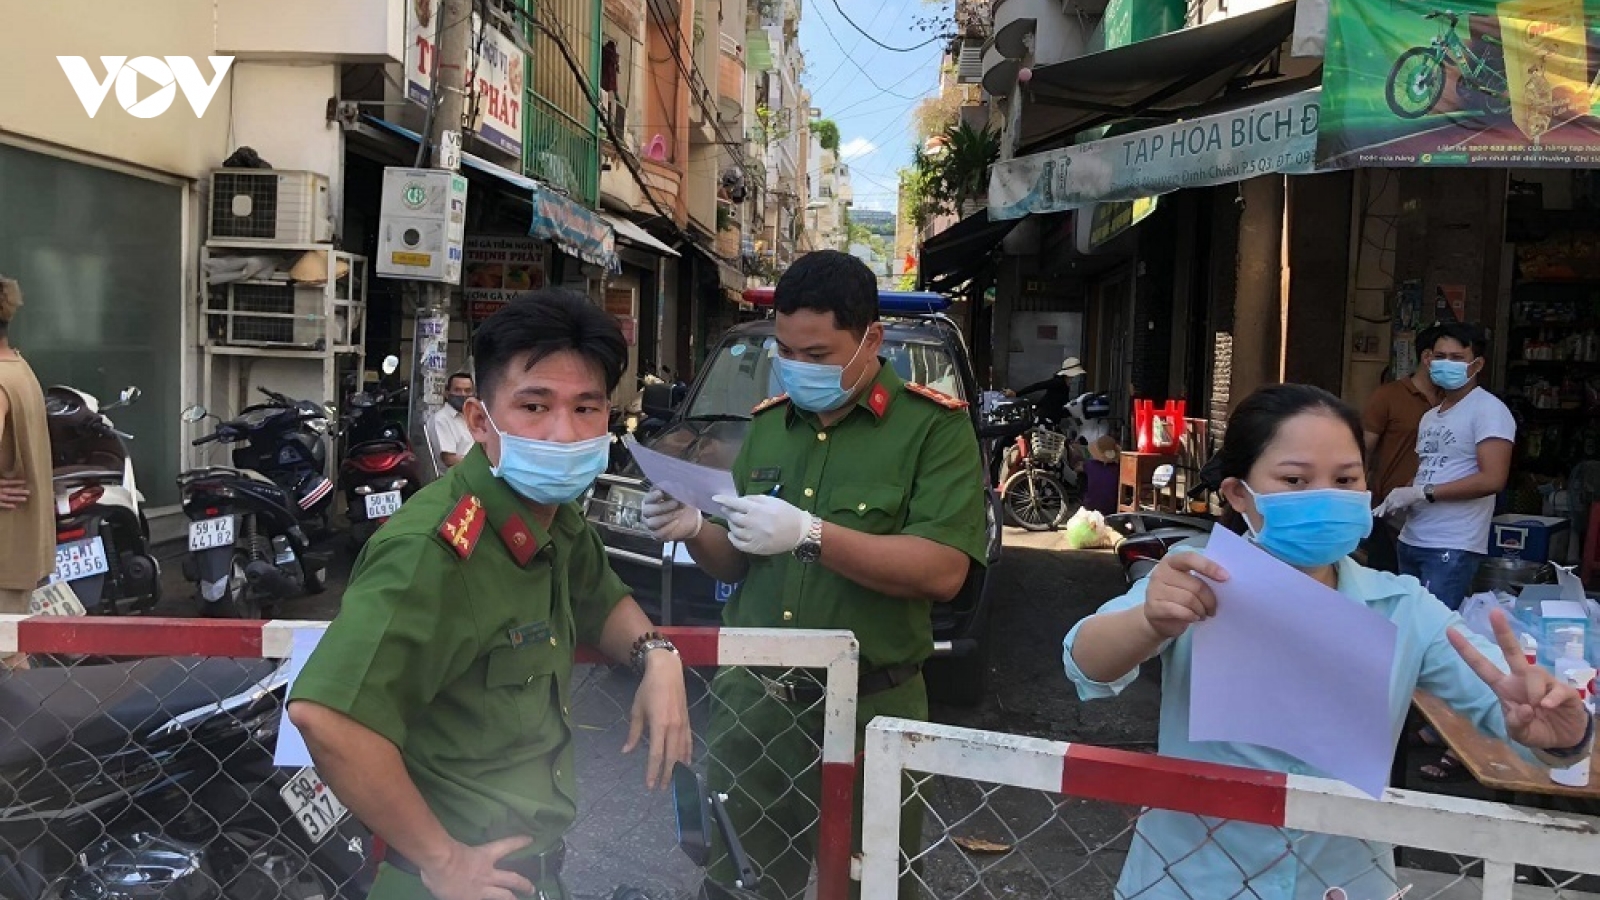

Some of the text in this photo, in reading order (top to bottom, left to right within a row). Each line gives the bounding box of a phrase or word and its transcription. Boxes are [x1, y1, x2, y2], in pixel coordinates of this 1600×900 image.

[1123, 134, 1164, 171] TẠP
[1170, 119, 1222, 158] HÓA
[1231, 108, 1292, 148] BÍCH
